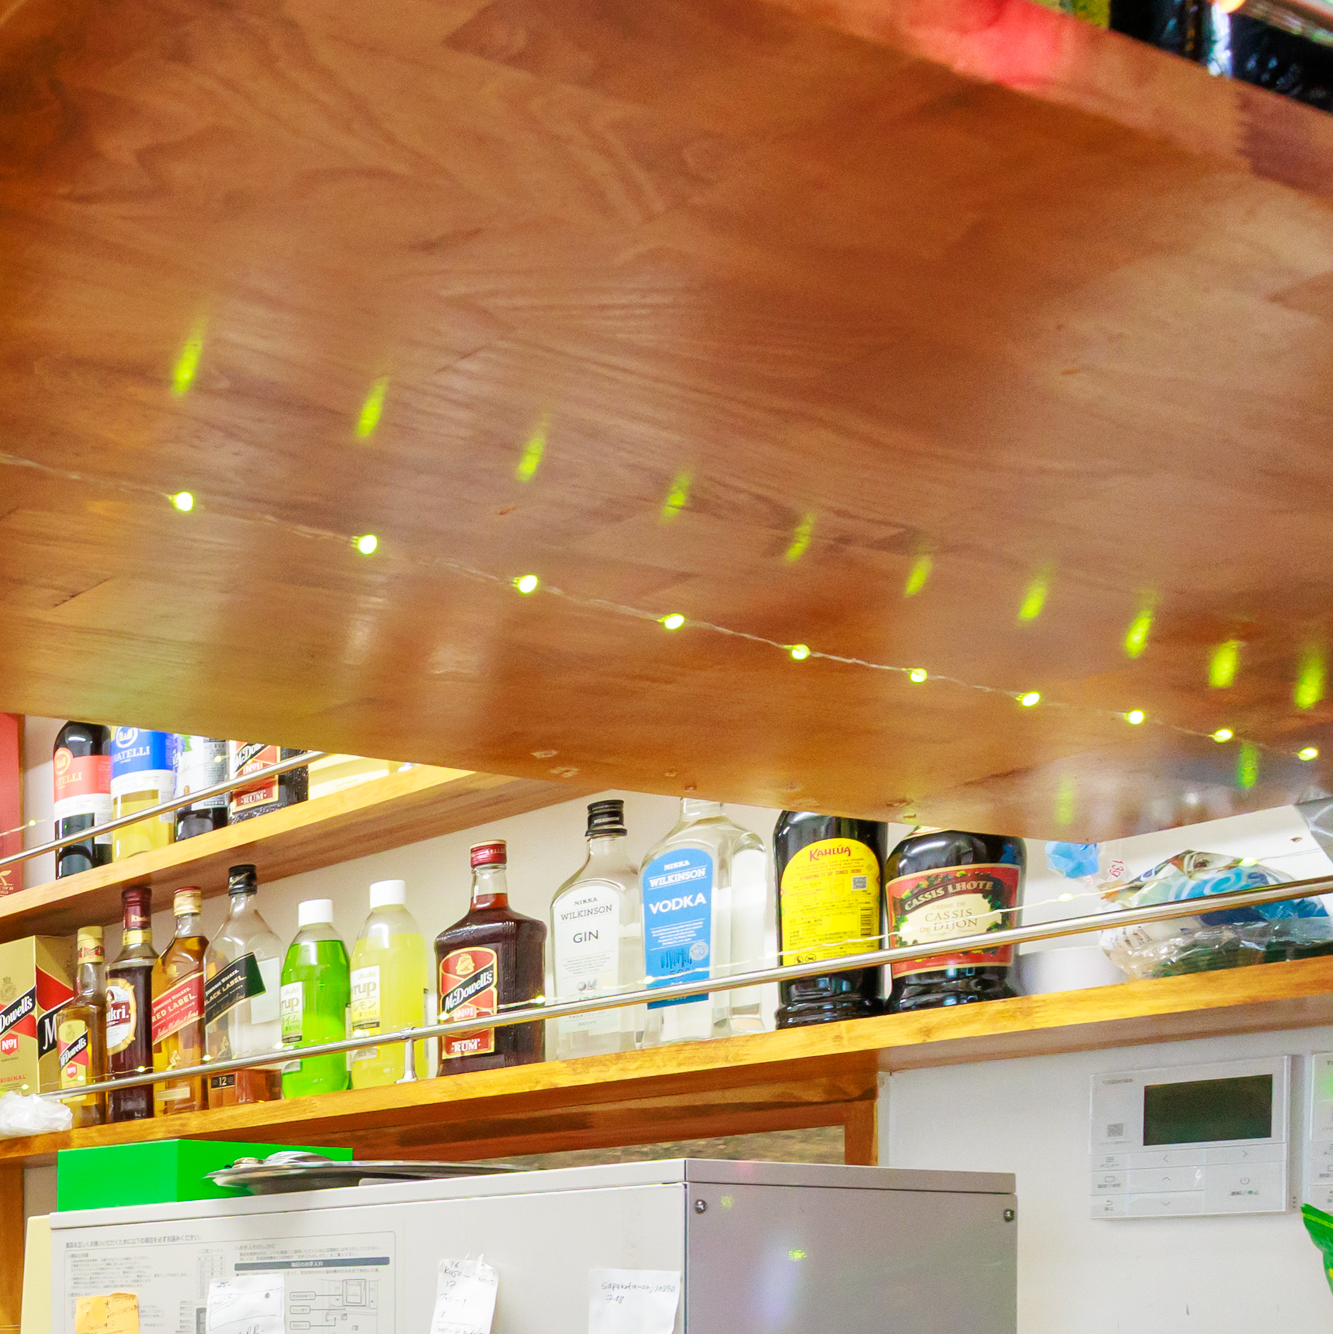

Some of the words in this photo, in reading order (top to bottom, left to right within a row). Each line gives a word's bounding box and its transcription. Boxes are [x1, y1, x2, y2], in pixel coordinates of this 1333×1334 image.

[664, 860, 690, 871] NIKKA
[649, 868, 706, 888] WILKINSON
[574, 897, 598, 906] NIKKA
[904, 886, 945, 910] CASSIS
[946, 880, 993, 895] LHOTE
[649, 892, 707, 915] VODKA
[560, 904, 613, 921] WILKINSON
[925, 908, 973, 922] CASSIS
[933, 918, 978, 933] DIJON
[573, 930, 599, 944] GIN
[353, 981, 377, 997] rup
[152, 1008, 167, 1023] RED
[454, 1040, 478, 1052] RUM
